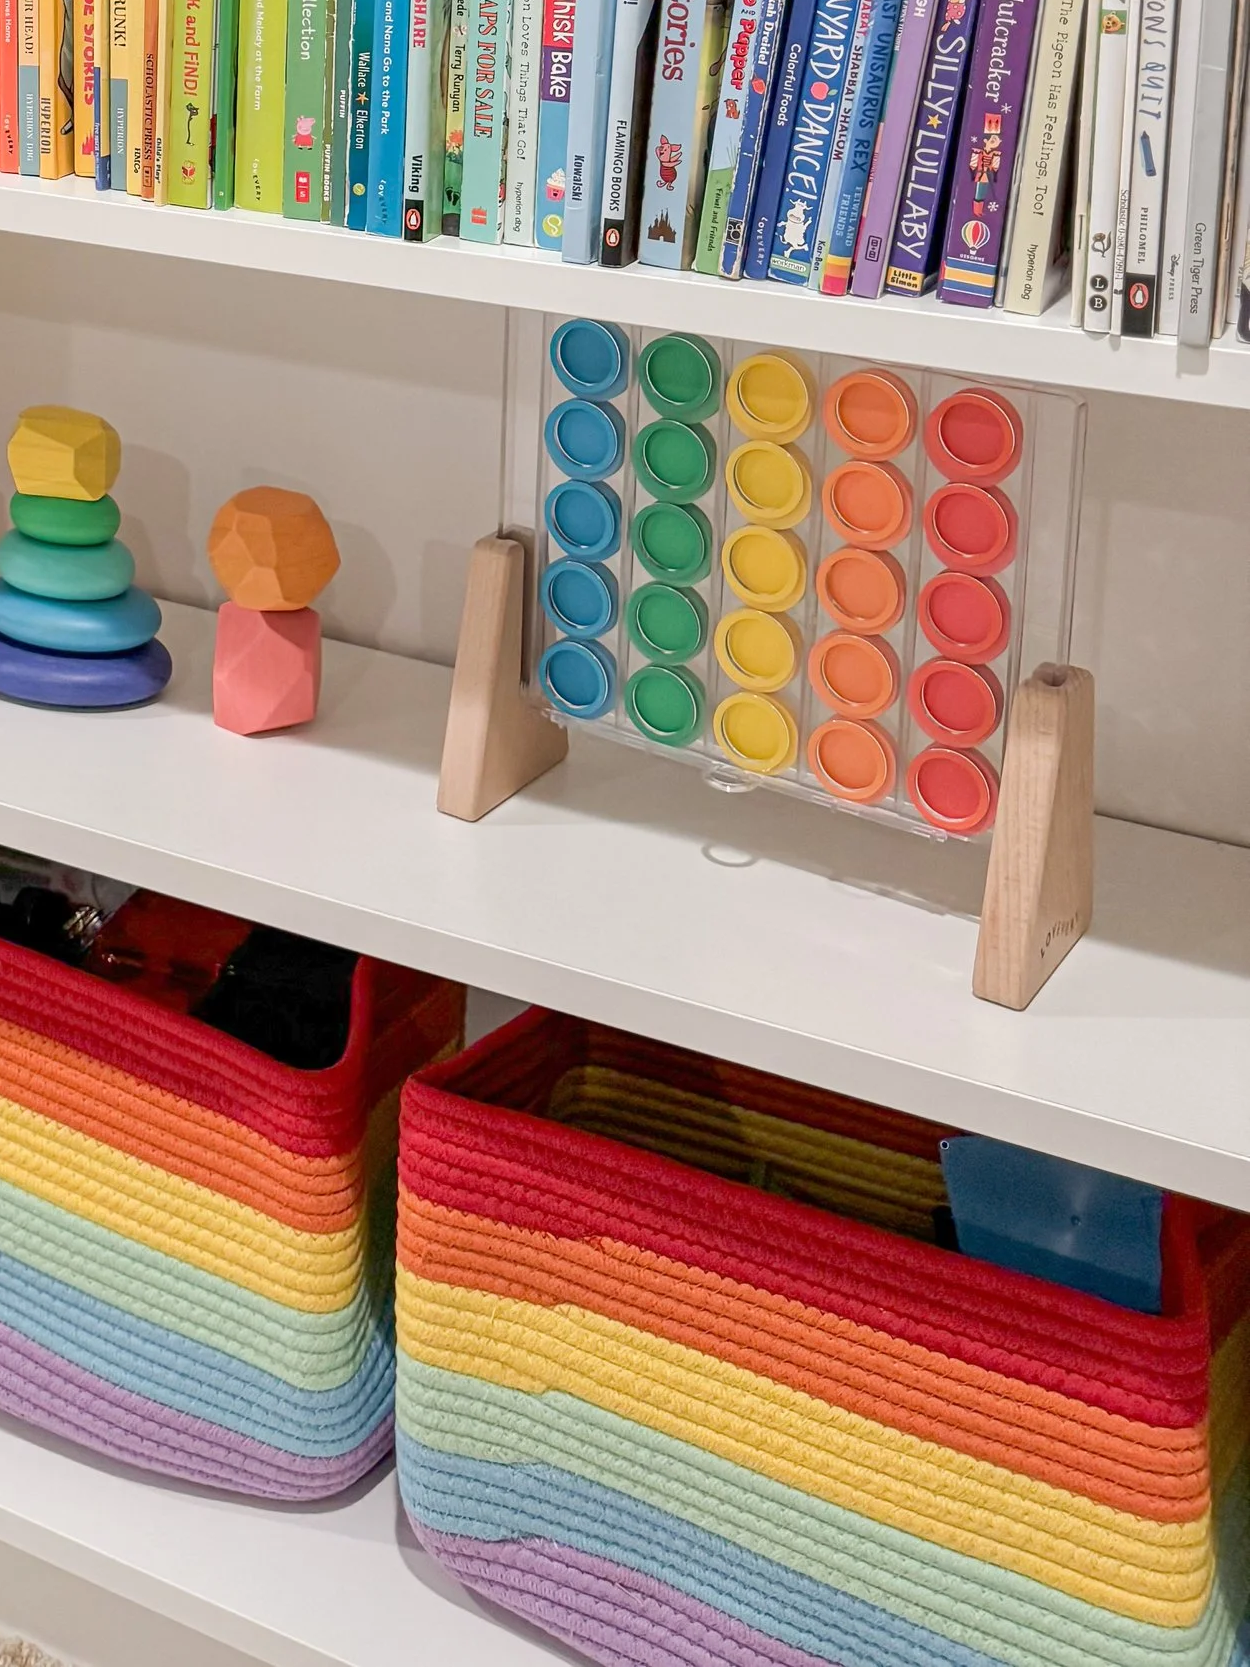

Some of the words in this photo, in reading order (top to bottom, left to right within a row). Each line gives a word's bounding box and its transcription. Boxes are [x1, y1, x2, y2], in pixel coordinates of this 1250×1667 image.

[384, 2, 394, 22] and
[1058, 0, 1074, 25] The
[25, 16, 34, 54] HEAD!
[185, 16, 201, 46] and
[254, 11, 264, 47] Melody
[384, 25, 393, 54] Nana
[520, 17, 532, 56] Loves
[758, 21, 774, 65] Dreidel
[255, 51, 262, 61] at
[357, 52, 370, 87] Wallace
[383, 57, 391, 72] Go
[783, 44, 801, 91] Colorful
[1049, 32, 1070, 79] Pigeon
[382, 76, 390, 86] to
[516, 62, 530, 102] Things
[549, 51, 572, 98] Bake
[859, 33, 892, 129] UNISAURUS
[382, 90, 390, 107] the
[777, 94, 792, 126] Foods
[1047, 84, 1062, 109] Has
[356, 110, 368, 149] Elkerton
[380, 111, 390, 134] Park
[517, 108, 527, 134] That
[516, 140, 526, 160] Go!
[786, 100, 835, 200] DANCE!
[851, 139, 870, 173] REX
[1035, 115, 1057, 180] Feelings,
[850, 187, 863, 223] FEIWEL
[1032, 185, 1048, 216] Too!
[846, 226, 855, 246] AND
